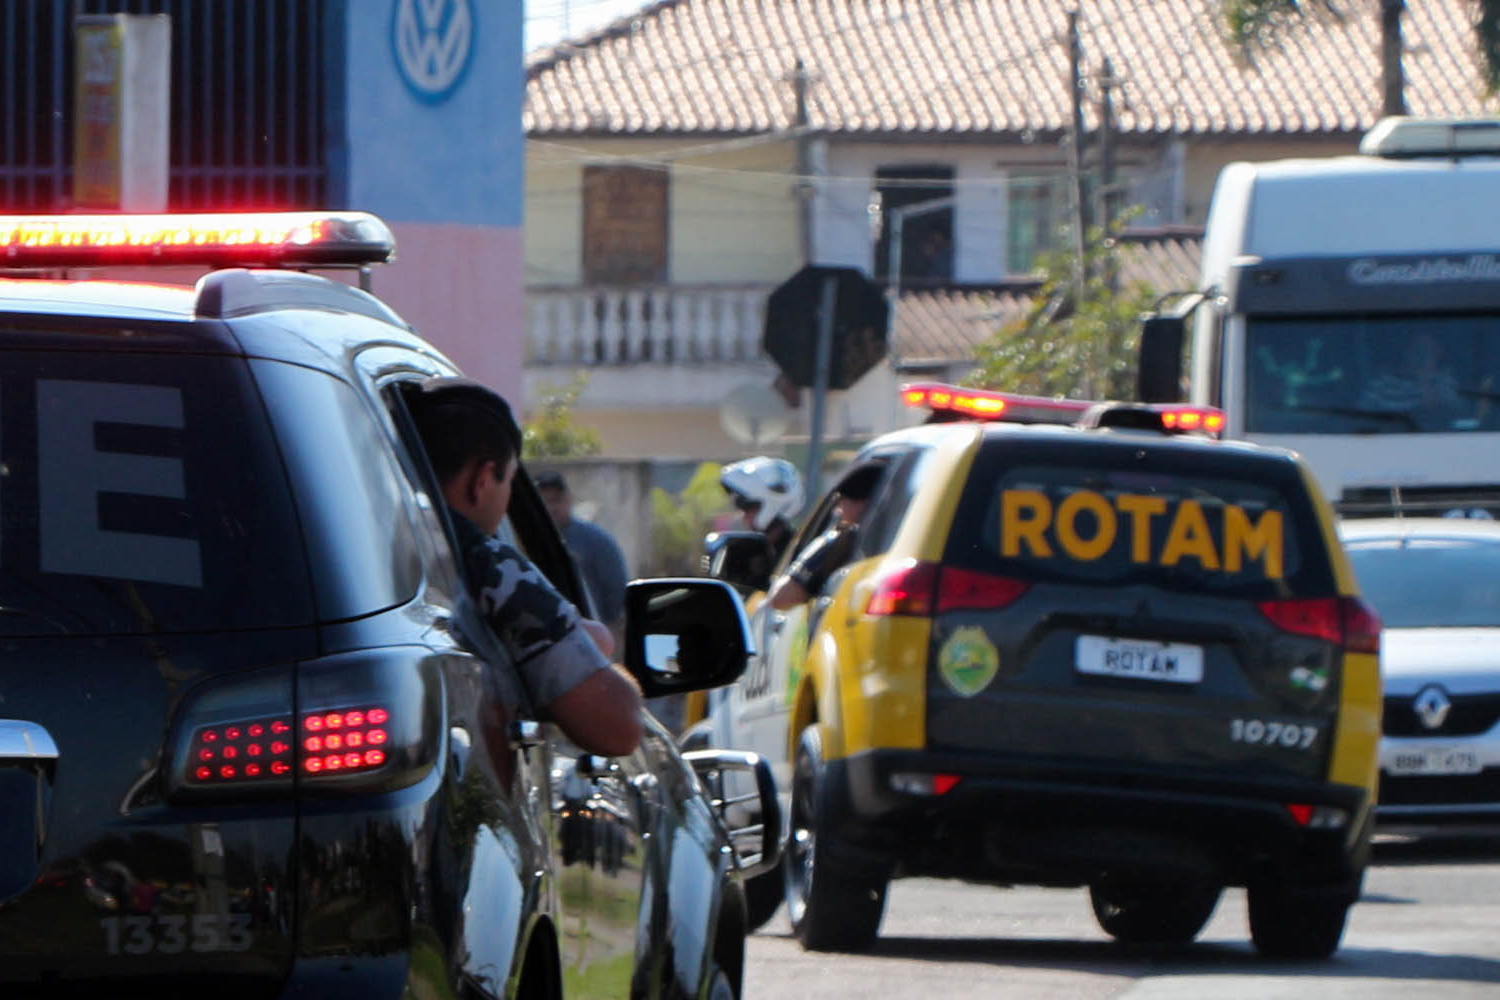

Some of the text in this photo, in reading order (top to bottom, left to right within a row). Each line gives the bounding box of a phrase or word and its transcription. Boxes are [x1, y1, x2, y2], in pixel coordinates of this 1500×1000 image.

[1002, 489, 1284, 580] ROTAM
[1104, 649, 1180, 675] ROTAM
[1228, 718, 1319, 749] 10707
